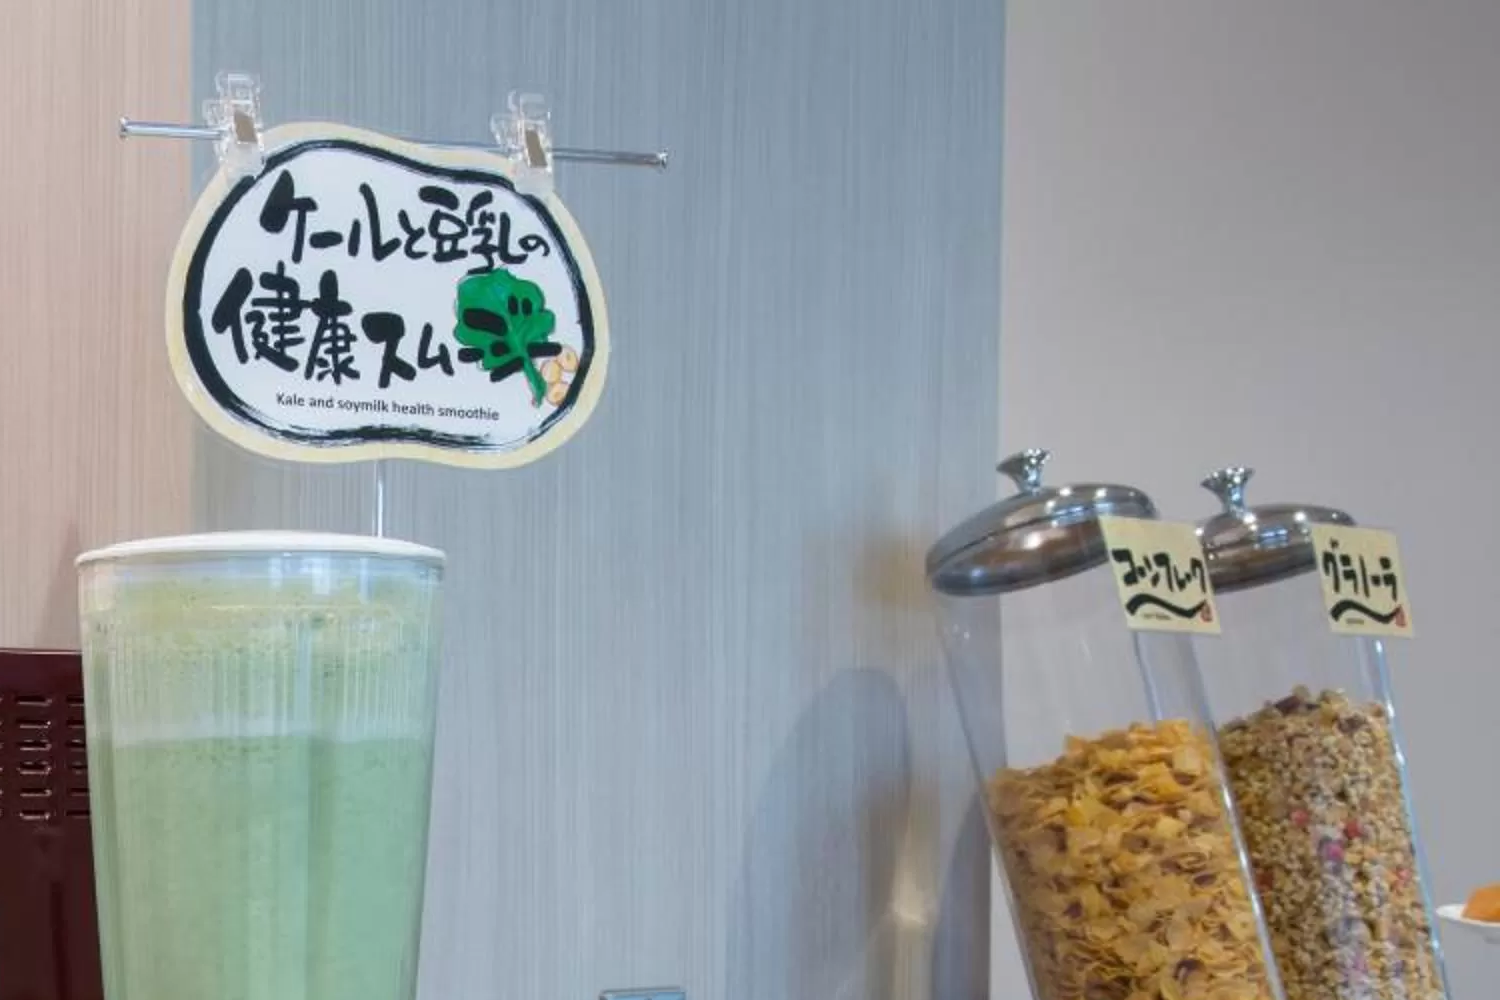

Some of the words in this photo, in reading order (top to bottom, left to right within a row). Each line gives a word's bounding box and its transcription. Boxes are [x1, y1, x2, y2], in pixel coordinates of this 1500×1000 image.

[259, 169, 551, 275] ケールと豆乳の
[211, 261, 563, 389] 健康スムージー
[276, 392, 305, 407] Kale
[309, 396, 334, 409] and
[337, 399, 389, 414] soymilk
[392, 401, 435, 417] health
[438, 404, 500, 421] smoothie
